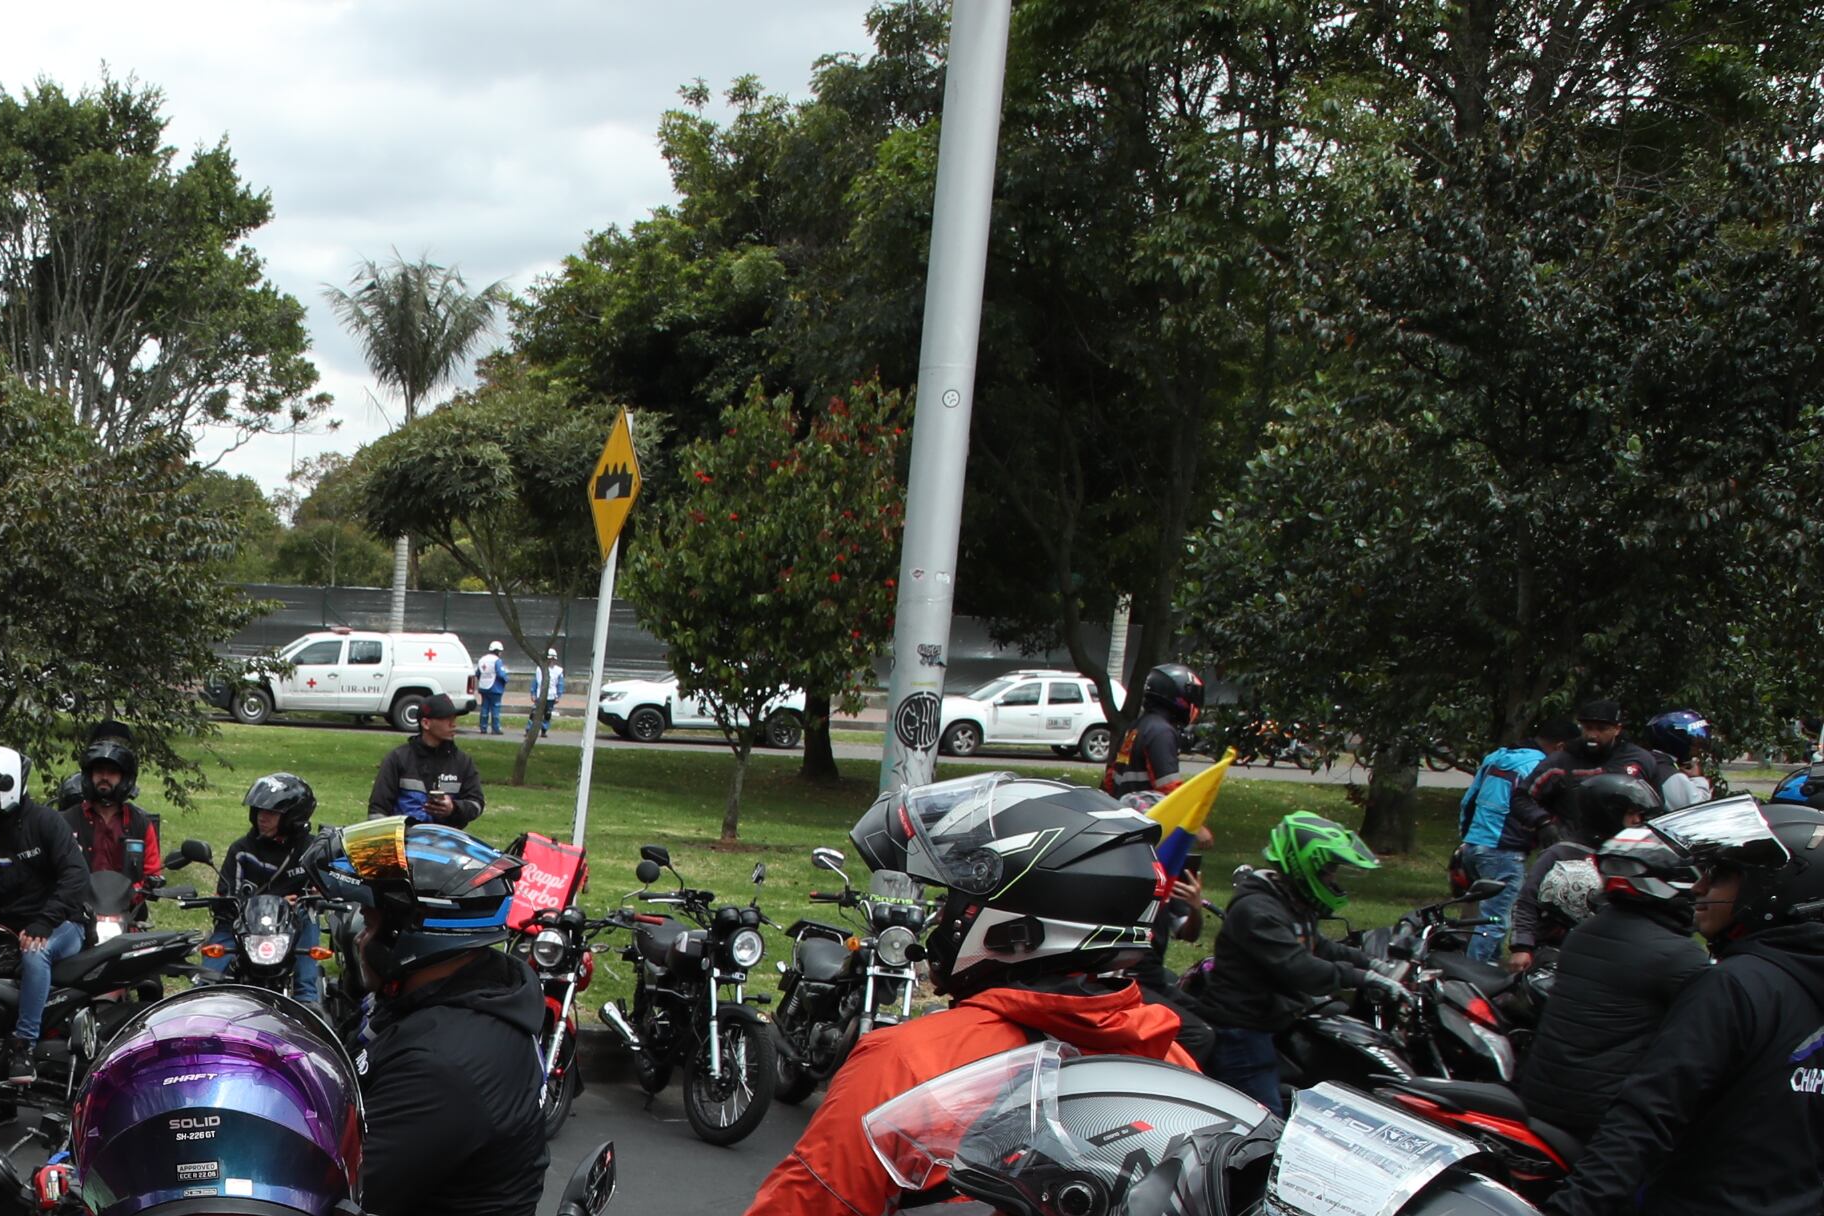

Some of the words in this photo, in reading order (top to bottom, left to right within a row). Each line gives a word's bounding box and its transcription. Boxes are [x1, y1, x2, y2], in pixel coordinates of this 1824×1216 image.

[522, 862, 568, 889] Rappi
[516, 880, 560, 908] Turbo
[163, 1073, 218, 1086] SHAFT
[169, 1115, 221, 1129] SOLID
[205, 1130, 216, 1139] GT
[179, 1163, 216, 1172] APPROVED
